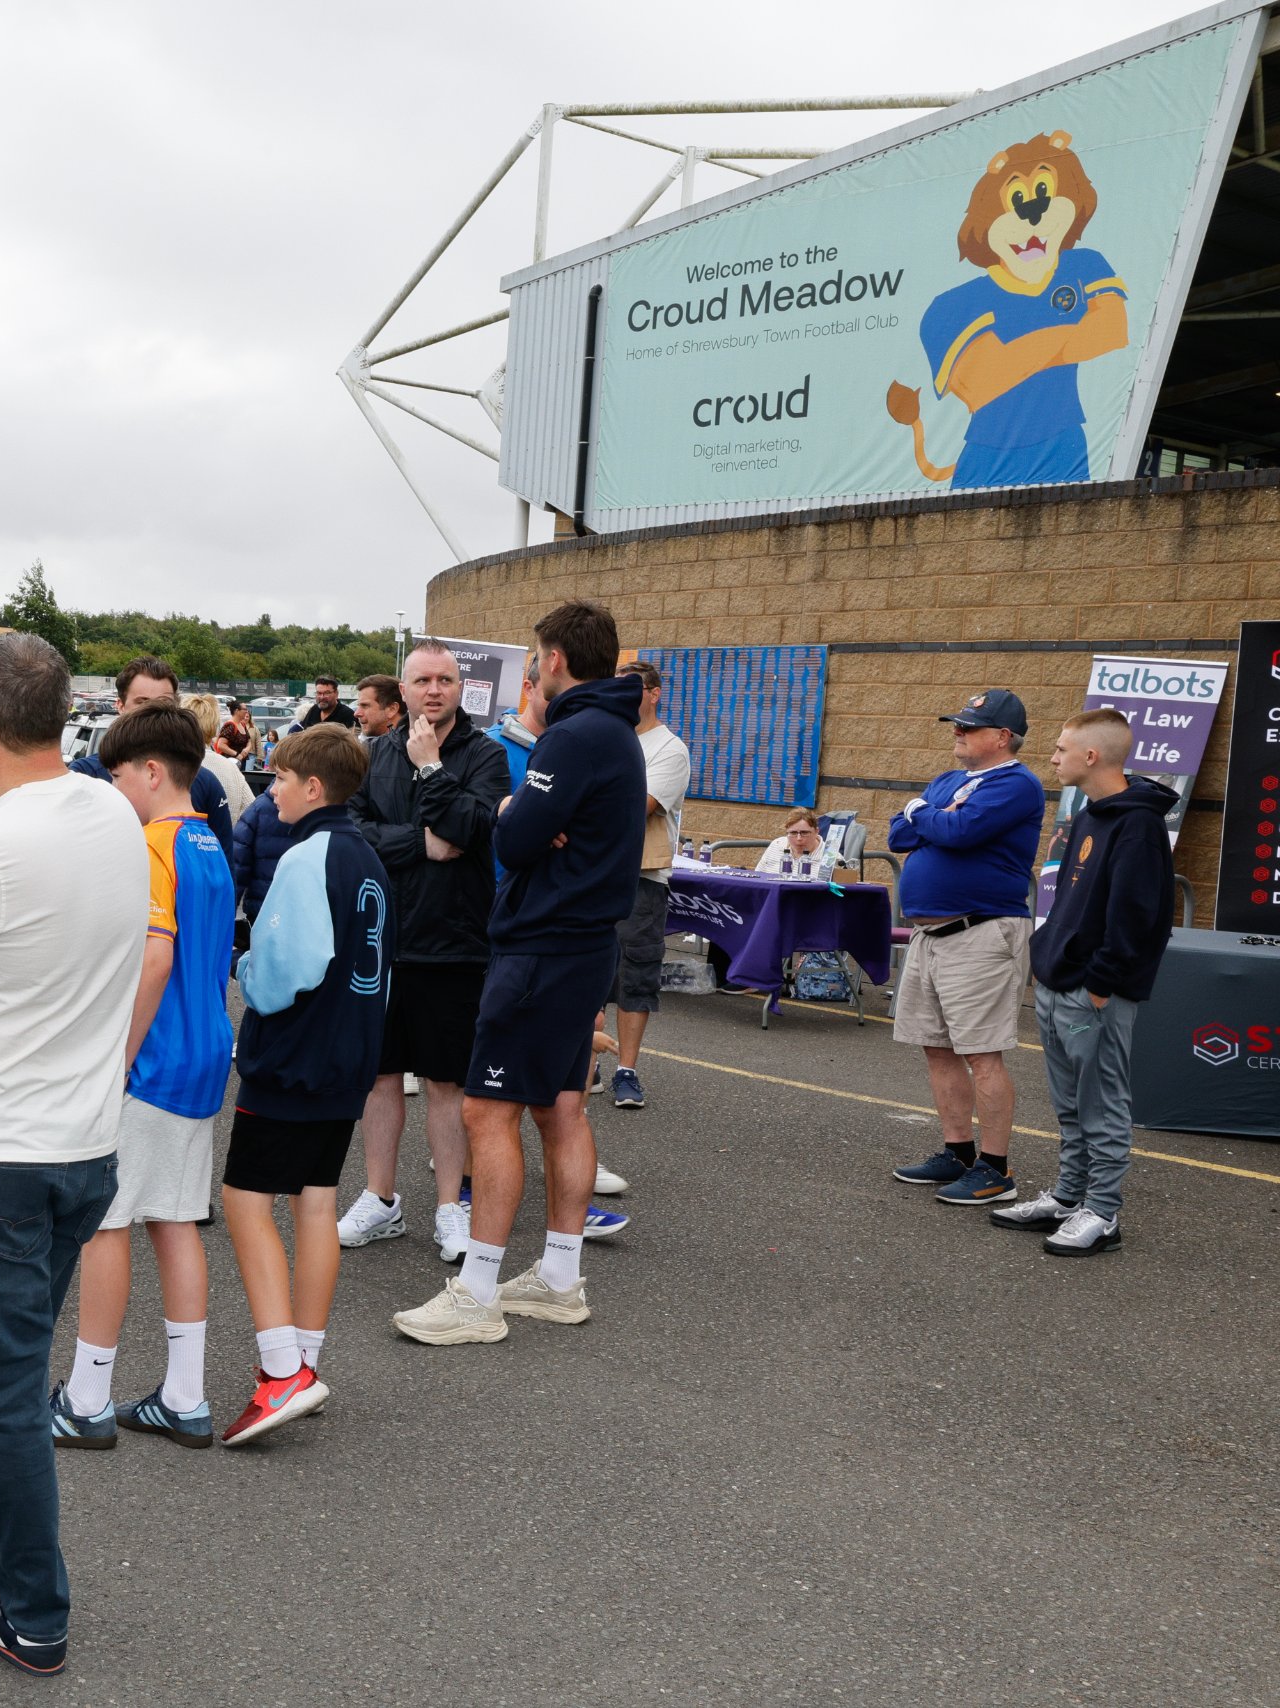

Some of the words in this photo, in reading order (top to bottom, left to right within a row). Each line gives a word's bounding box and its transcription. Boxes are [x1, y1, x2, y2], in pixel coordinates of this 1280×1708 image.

[686, 257, 773, 284] Welcome
[779, 251, 799, 269] to
[804, 245, 838, 265] the
[627, 286, 728, 333] Croud
[739, 268, 904, 318] Meadow
[626, 345, 662, 361] Home
[665, 341, 679, 356] of
[682, 334, 759, 354] Shrewsbury
[763, 328, 800, 343] Town
[804, 317, 860, 339] Football
[864, 313, 899, 331] Club
[692, 373, 810, 428] croud
[693, 441, 731, 460] Digital
[735, 436, 802, 453] marketing,
[1097, 665, 1215, 698] talbots
[1143, 706, 1193, 729] Law
[1134, 741, 1180, 764] Life
[459, 1310, 489, 1327] HOKA
